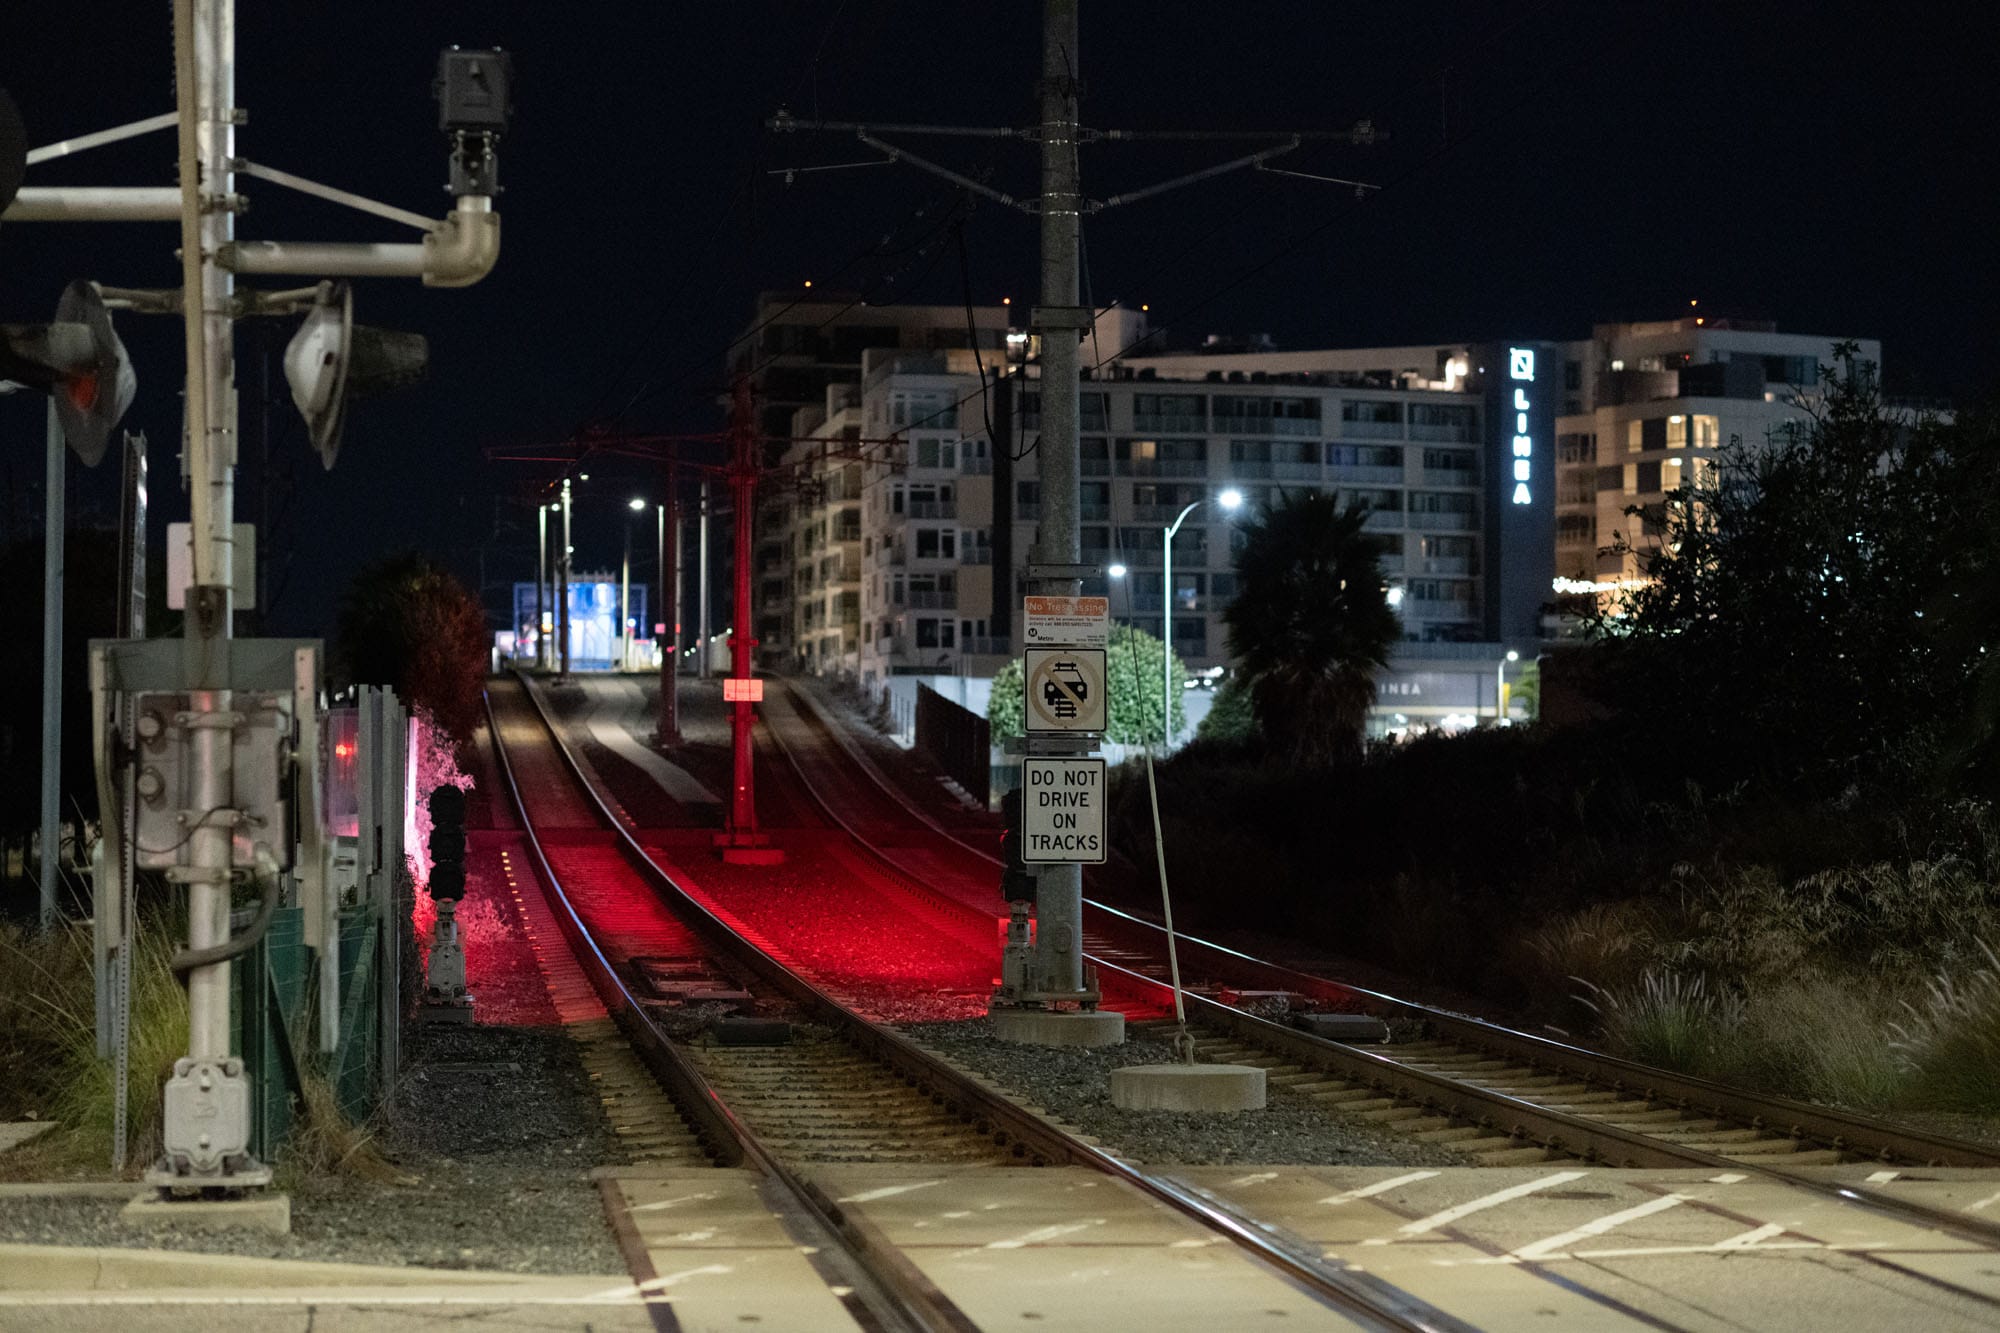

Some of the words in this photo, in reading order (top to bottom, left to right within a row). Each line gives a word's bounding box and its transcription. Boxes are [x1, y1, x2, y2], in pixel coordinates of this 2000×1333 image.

[1029, 602, 1043, 611] No
[1047, 602, 1104, 613] Tresssing
[1381, 682, 1421, 695] INEA
[1031, 770, 1054, 786] DO
[1064, 770, 1098, 786] NOT
[1039, 791, 1090, 807] DRIVE
[1053, 813, 1076, 829] ON
[1030, 834, 1099, 850] TRACKS
